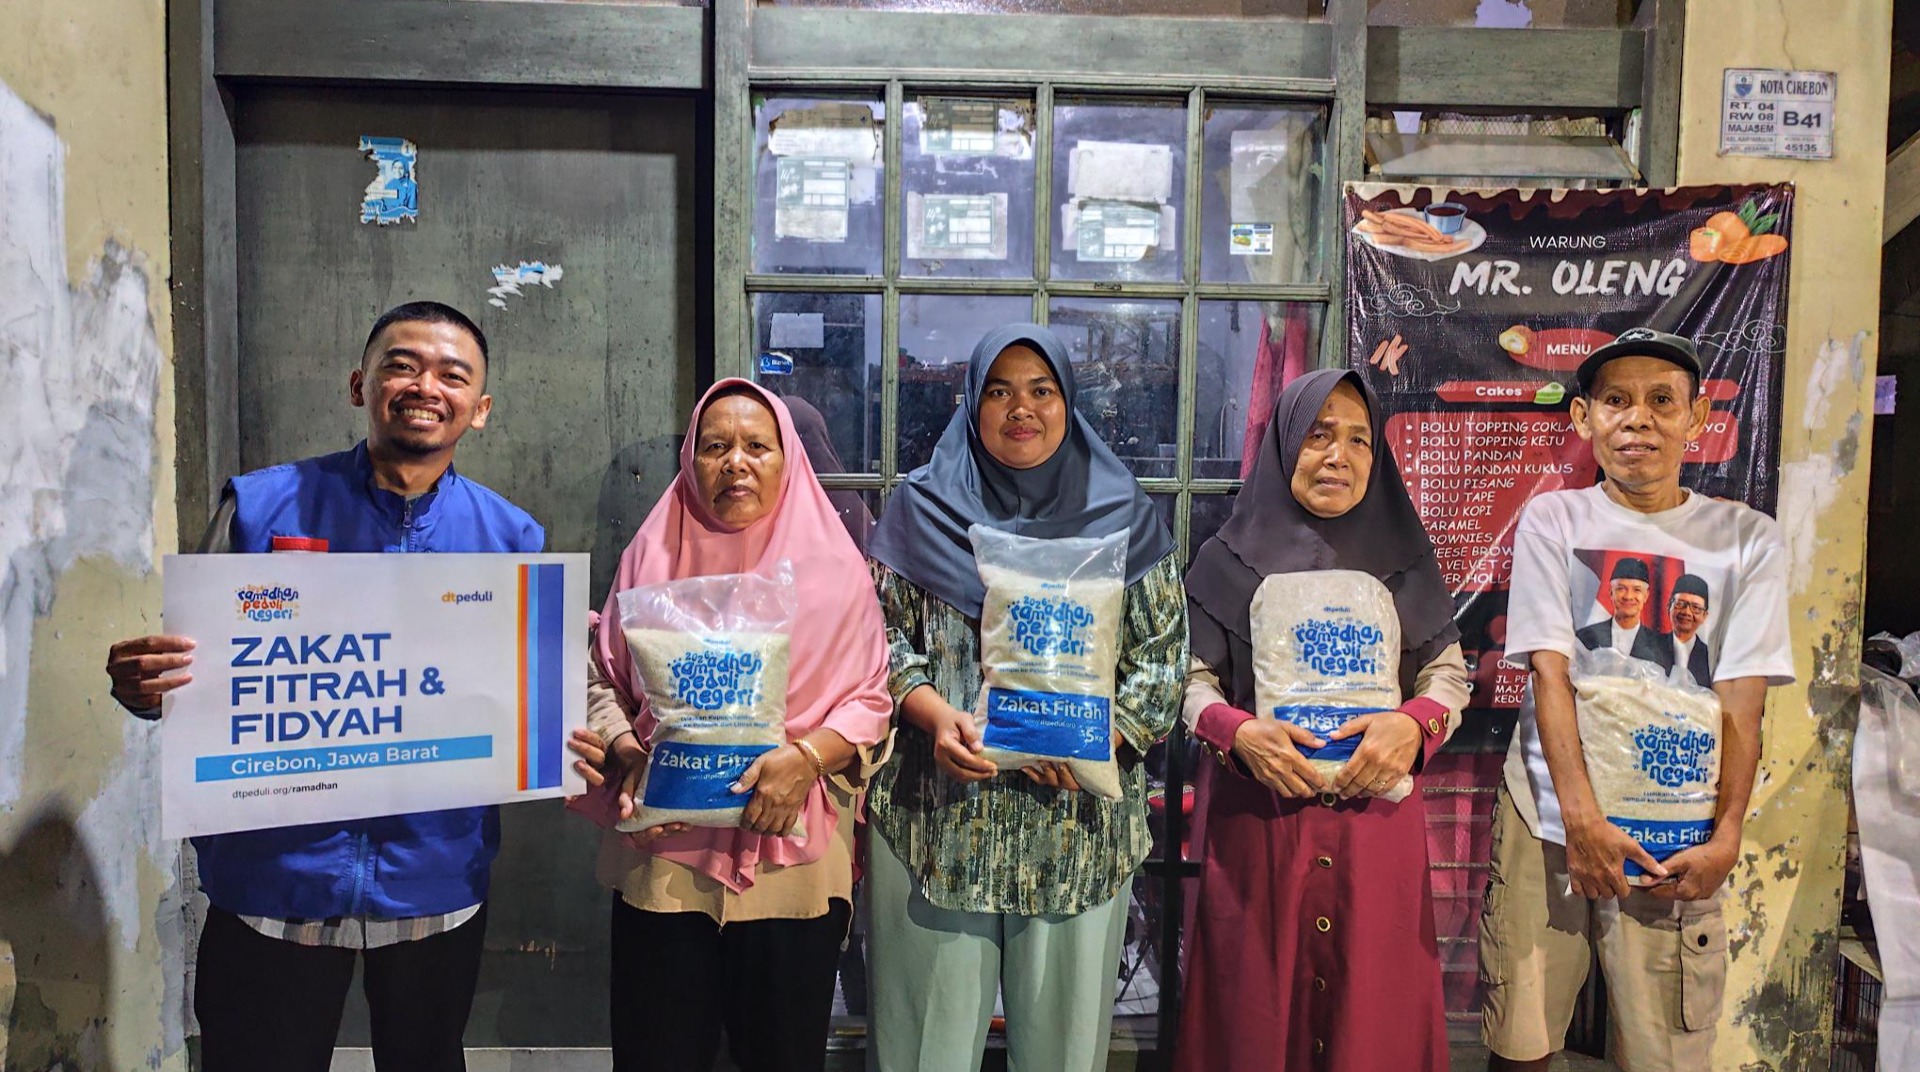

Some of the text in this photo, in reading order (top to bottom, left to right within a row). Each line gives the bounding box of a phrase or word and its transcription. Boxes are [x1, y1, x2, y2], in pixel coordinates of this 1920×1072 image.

[1760, 80, 1828, 95] KOTA CIREBON
[1730, 102, 1774, 111] RT. 04
[1729, 112, 1774, 121] RW 08
[1783, 111, 1822, 128] B41
[1727, 124, 1774, 133] MAJASEM
[1785, 144, 1817, 152] 45135
[1529, 235, 1606, 249] WARUNG
[1449, 259, 1686, 299] MR. OLENG
[1547, 343, 1591, 355] MENU
[1475, 386, 1522, 397] Cakes
[1421, 421, 1575, 433] BOLU TOPPING COKLA
[1421, 436, 1565, 447] BOLU TOPPING KEJU
[1421, 450, 1523, 461] BOLU PANDAN
[1421, 463, 1573, 475] BOLU PANDAN KUKUS
[1421, 478, 1515, 489] BOLU PISANG
[1421, 491, 1495, 503] BOLU TAPE
[1421, 505, 1492, 517] BOLU KOPI
[1422, 520, 1481, 531] CARAMEL
[1429, 533, 1493, 545] ROWNIES
[1446, 560, 1498, 571] VELVET
[238, 586, 299, 602] ramadhan
[441, 590, 493, 604] dtpeduli
[243, 597, 283, 613] peduli
[1024, 596, 1048, 609] 2026
[248, 609, 292, 622] negeri
[1010, 602, 1094, 627] ramadhan
[1307, 619, 1332, 632] 2026
[1295, 624, 1383, 645] ramadhan
[230, 632, 391, 668] ZAKAT
[1303, 639, 1361, 662] peduli
[685, 651, 710, 664] 2026
[672, 652, 762, 679] ramadhan
[1311, 656, 1376, 677] negeri
[231, 666, 446, 706] FITRAH &
[678, 670, 739, 698] peduli
[685, 689, 754, 711] negeri
[997, 695, 1102, 721] Zakat Fitrah
[231, 705, 403, 745] FIDYAH
[1648, 724, 1673, 738] 2026
[1635, 730, 1715, 754] ramadhan
[231, 744, 439, 775] Cirebon, Jawa Barat
[659, 750, 711, 770] Zakat
[1641, 747, 1699, 771] peduli
[1650, 766, 1708, 787] negeri
[232, 781, 338, 799] dtpeduli.org/ramadhan
